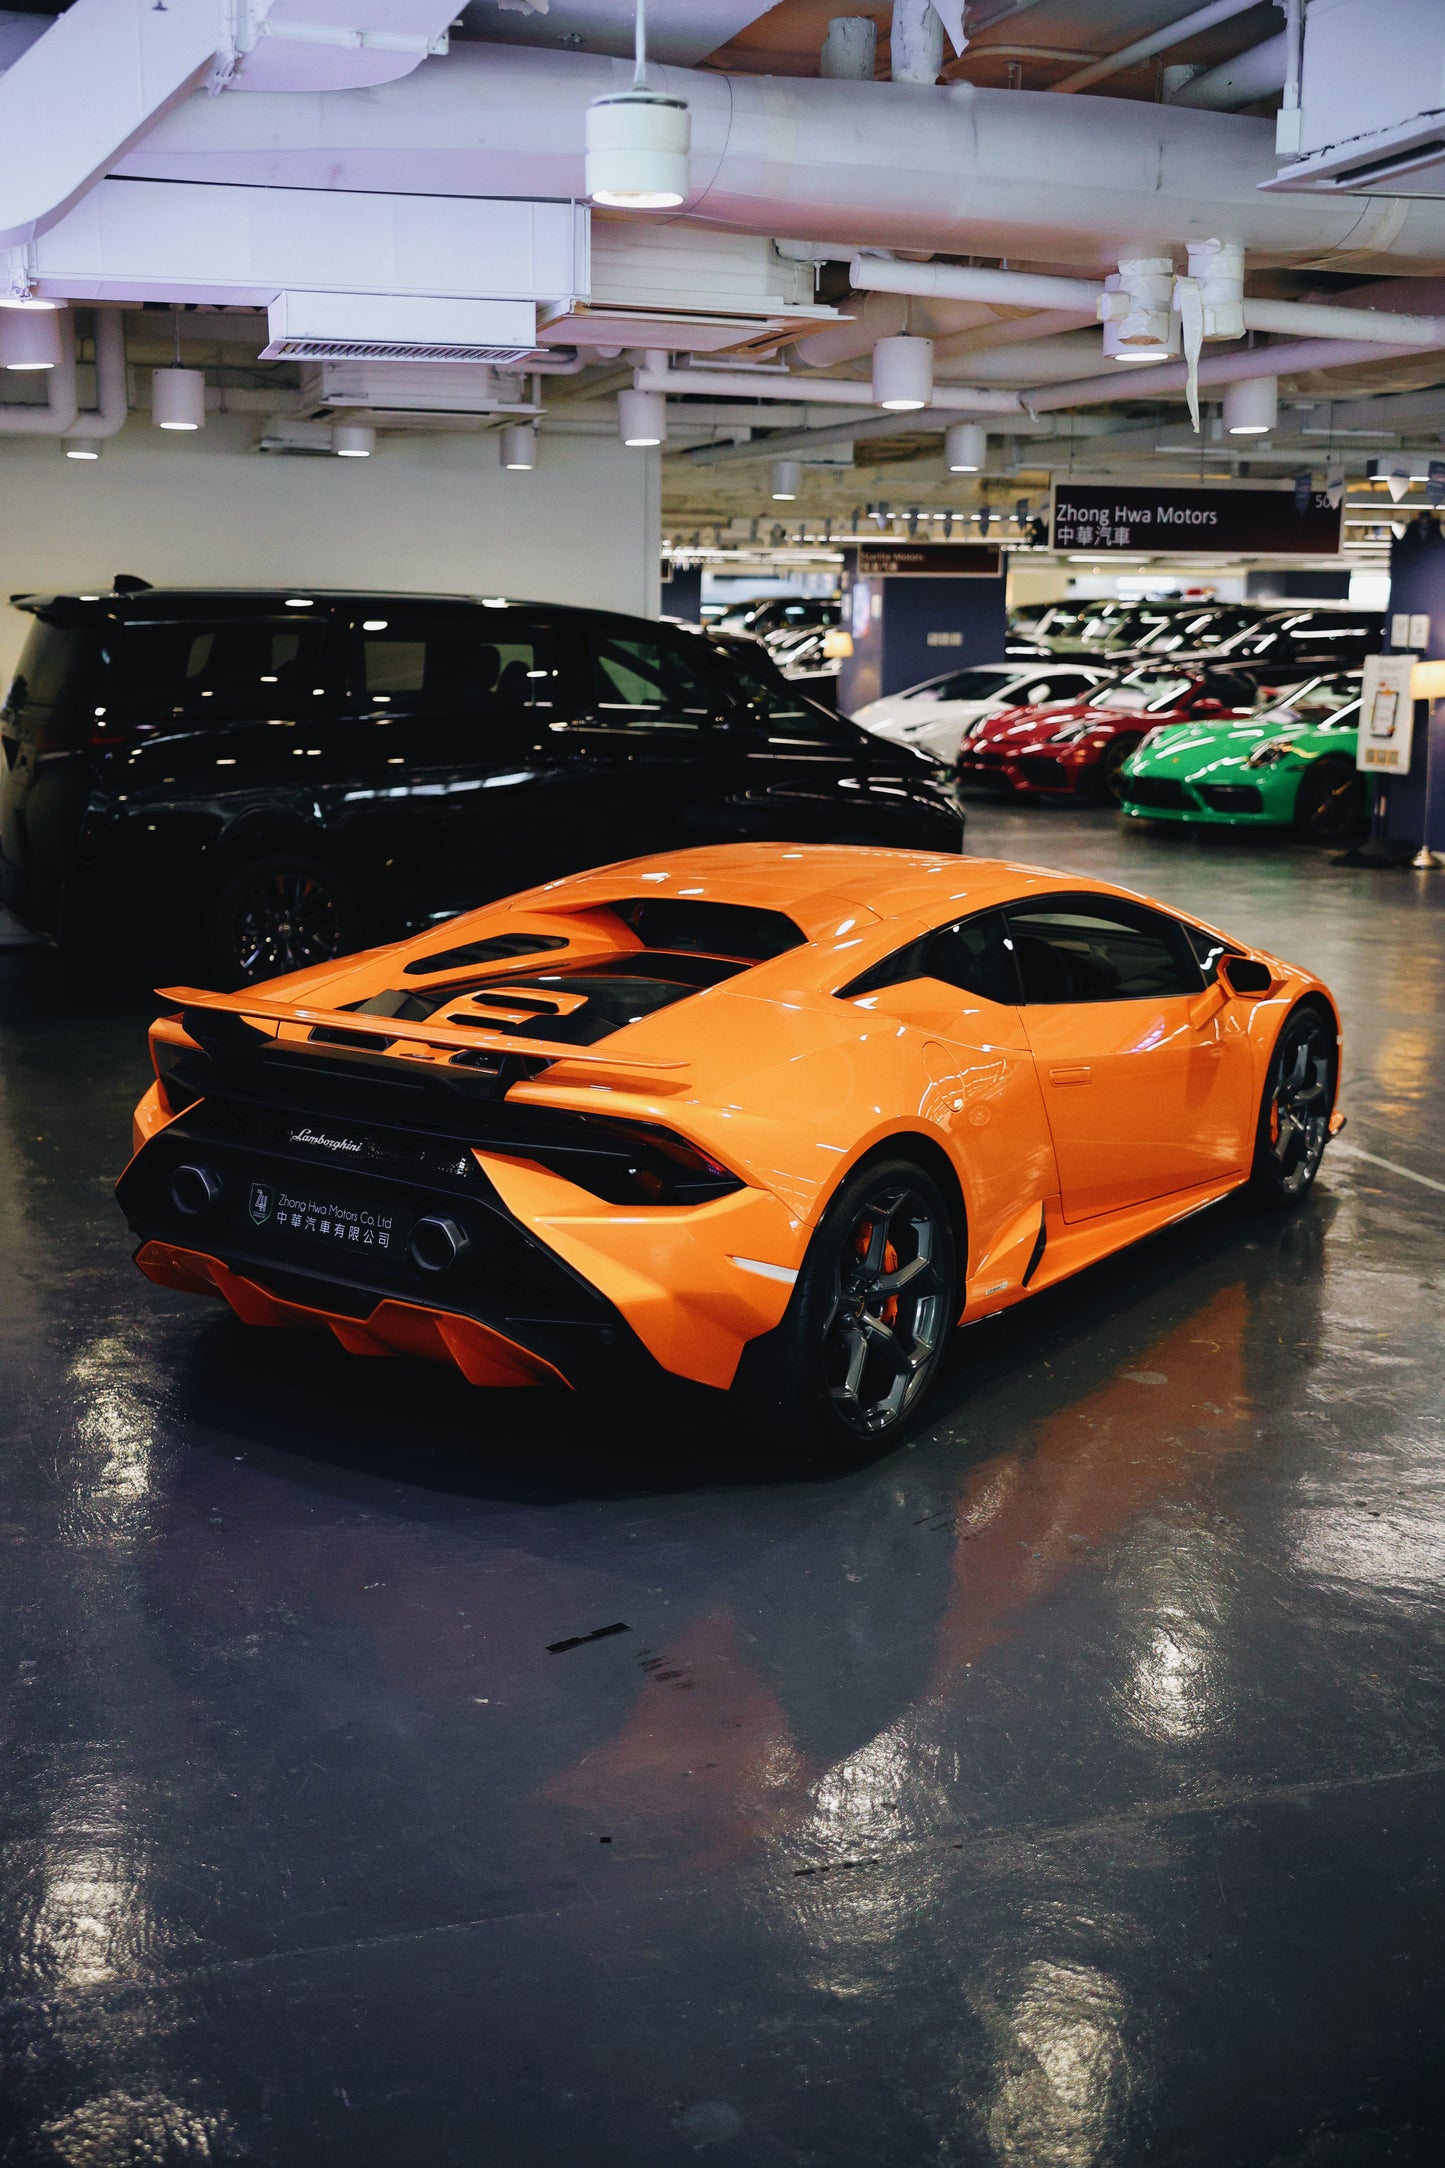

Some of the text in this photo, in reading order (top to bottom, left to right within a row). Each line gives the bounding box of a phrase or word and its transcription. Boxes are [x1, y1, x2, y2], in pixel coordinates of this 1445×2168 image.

[1056, 504, 1217, 526] Zhong Hwa Motors
[1057, 525, 1130, 546] 中華汽車
[292, 1128, 363, 1151] Lamborghini
[278, 1194, 307, 1212] Zhong
[308, 1200, 327, 1215] Hwa
[329, 1204, 358, 1221] Motors
[360, 1211, 375, 1225] Co.
[277, 1210, 390, 1248] 中華汽車有限公司
